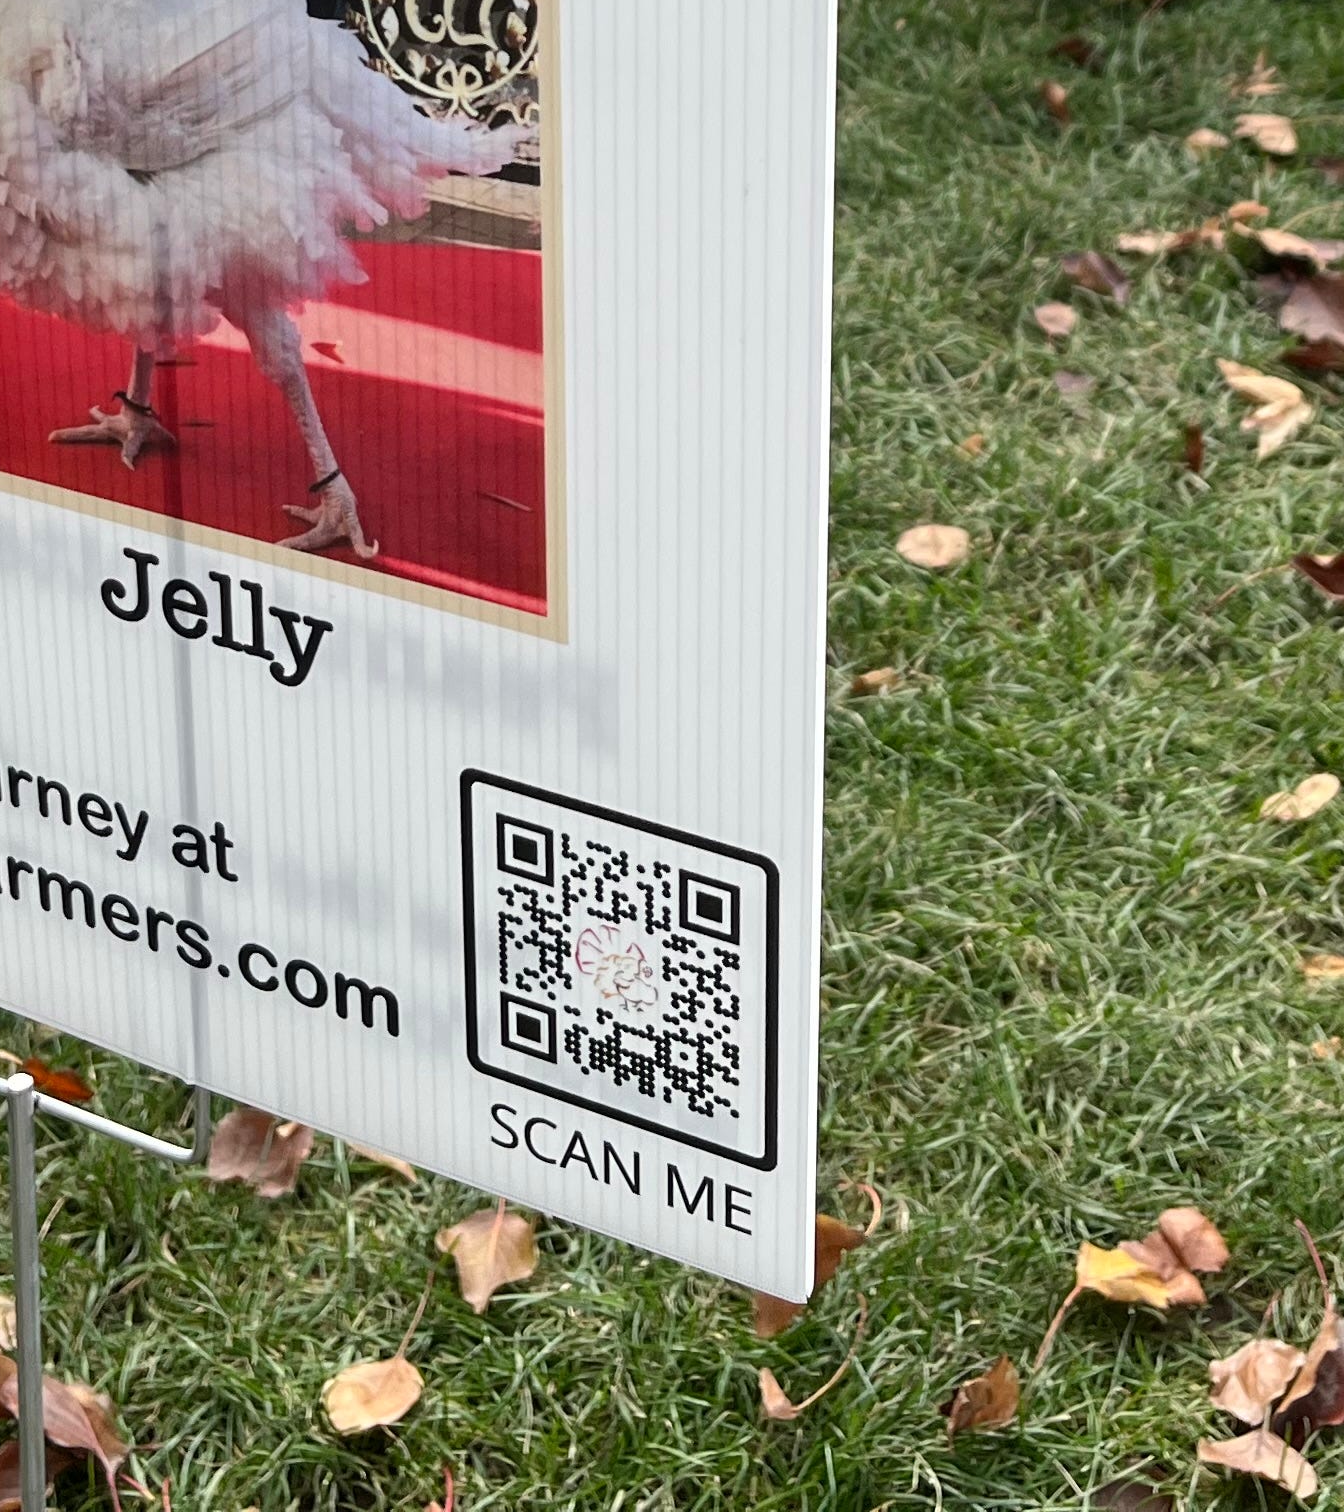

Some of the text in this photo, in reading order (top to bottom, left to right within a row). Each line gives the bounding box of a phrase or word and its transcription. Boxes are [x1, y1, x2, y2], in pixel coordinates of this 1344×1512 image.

[100, 547, 334, 687] Jelly
[171, 821, 239, 883] at
[489, 1103, 754, 1236] SCAN ME
